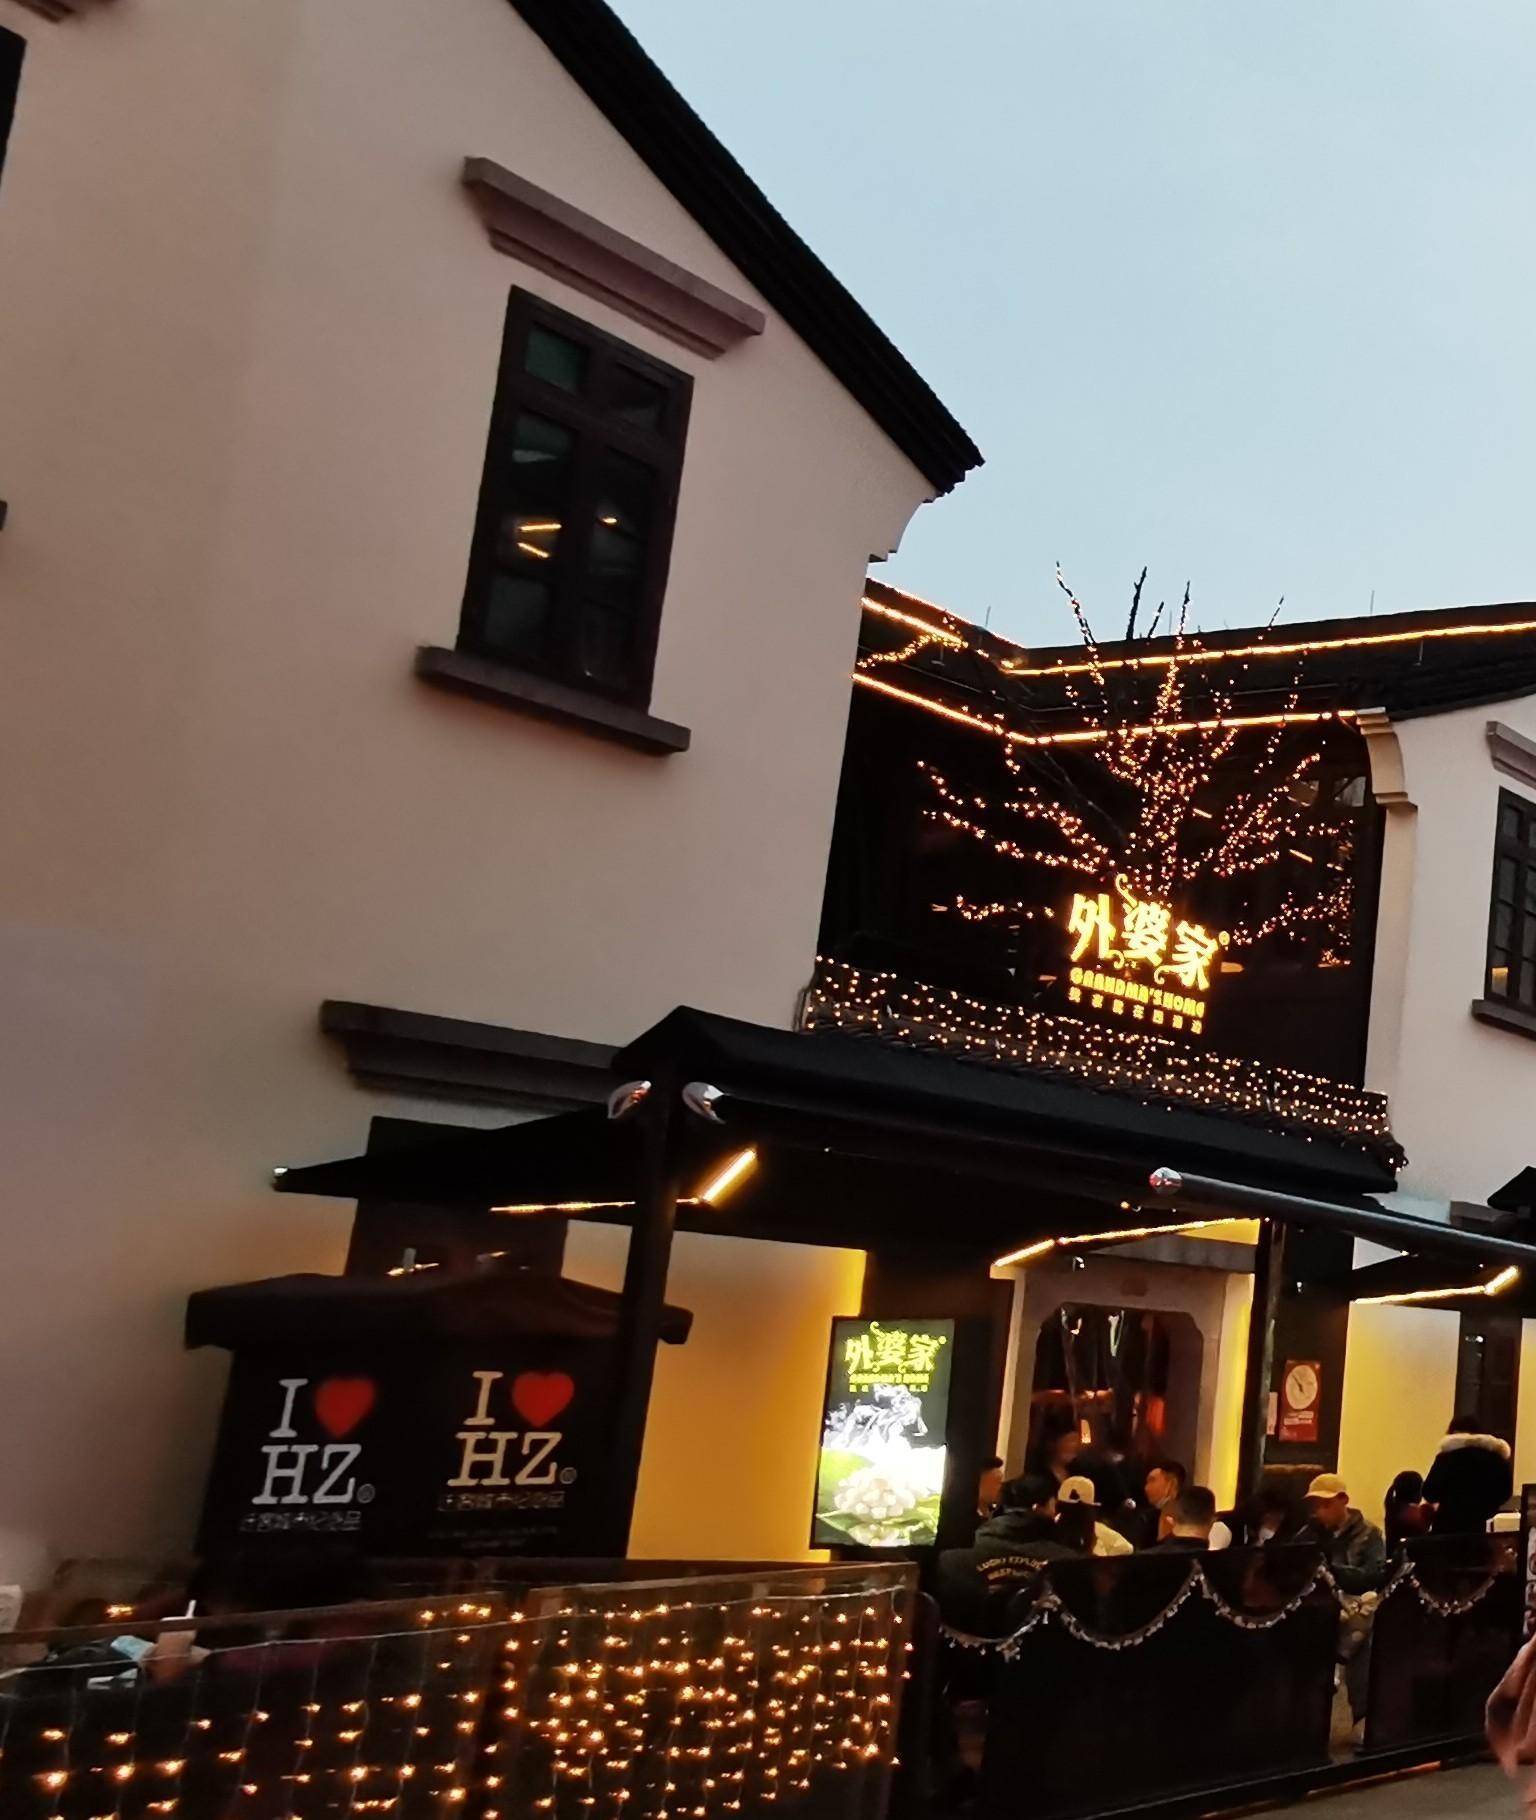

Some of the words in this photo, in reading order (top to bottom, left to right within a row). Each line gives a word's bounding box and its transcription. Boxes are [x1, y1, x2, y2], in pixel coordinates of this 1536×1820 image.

[1068, 876, 1219, 992] 外婆家
[845, 1322, 940, 1374] 外婆家
[269, 1378, 309, 1438] I
[463, 1371, 504, 1426] I
[252, 1444, 362, 1505] HZ
[447, 1432, 562, 1487] HZ
